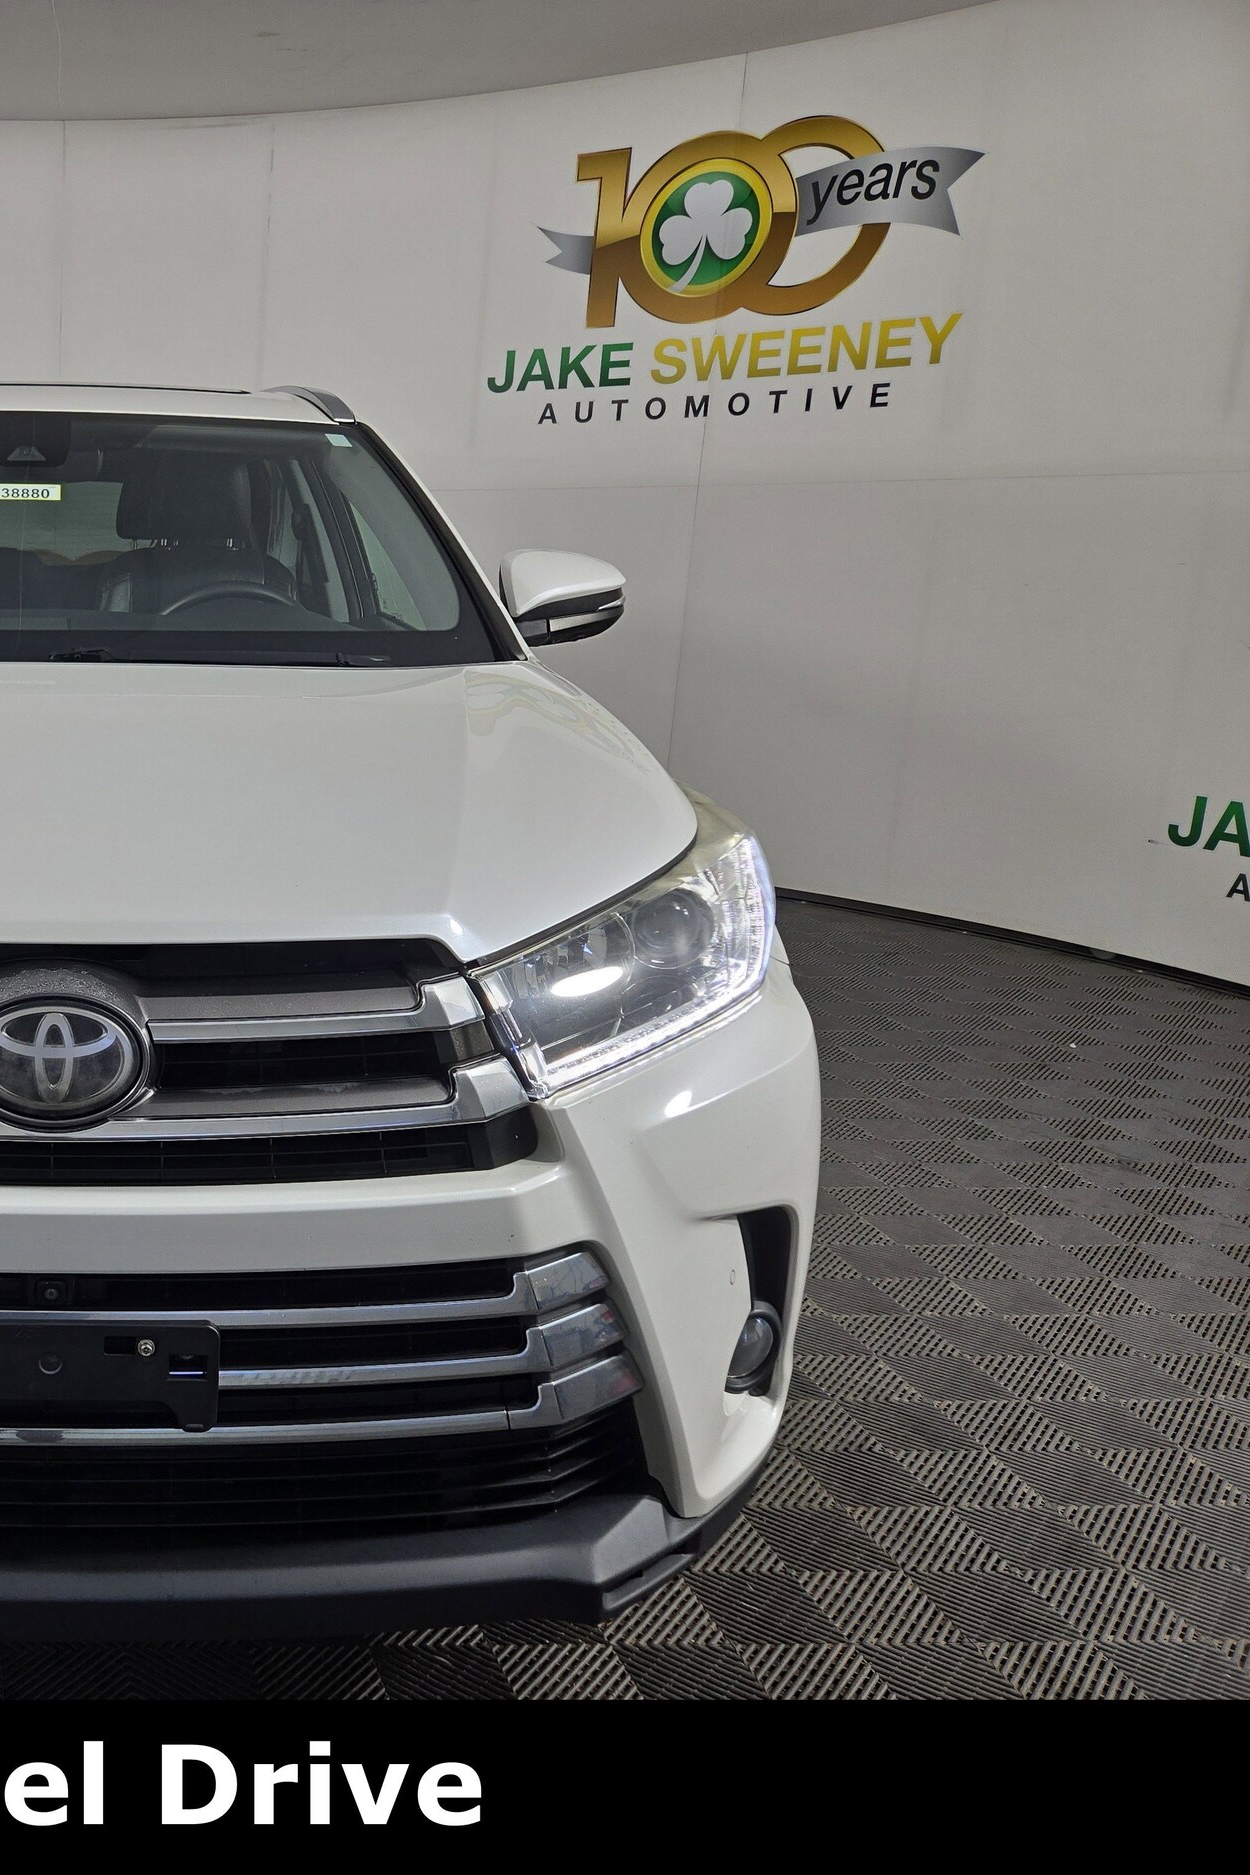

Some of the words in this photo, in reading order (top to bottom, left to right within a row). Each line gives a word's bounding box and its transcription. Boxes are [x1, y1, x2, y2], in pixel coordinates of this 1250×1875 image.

[806, 159, 940, 226] years
[487, 342, 634, 394] JAKE
[650, 312, 963, 385] SWEENEY
[538, 383, 892, 425] AUTOMOTIVE
